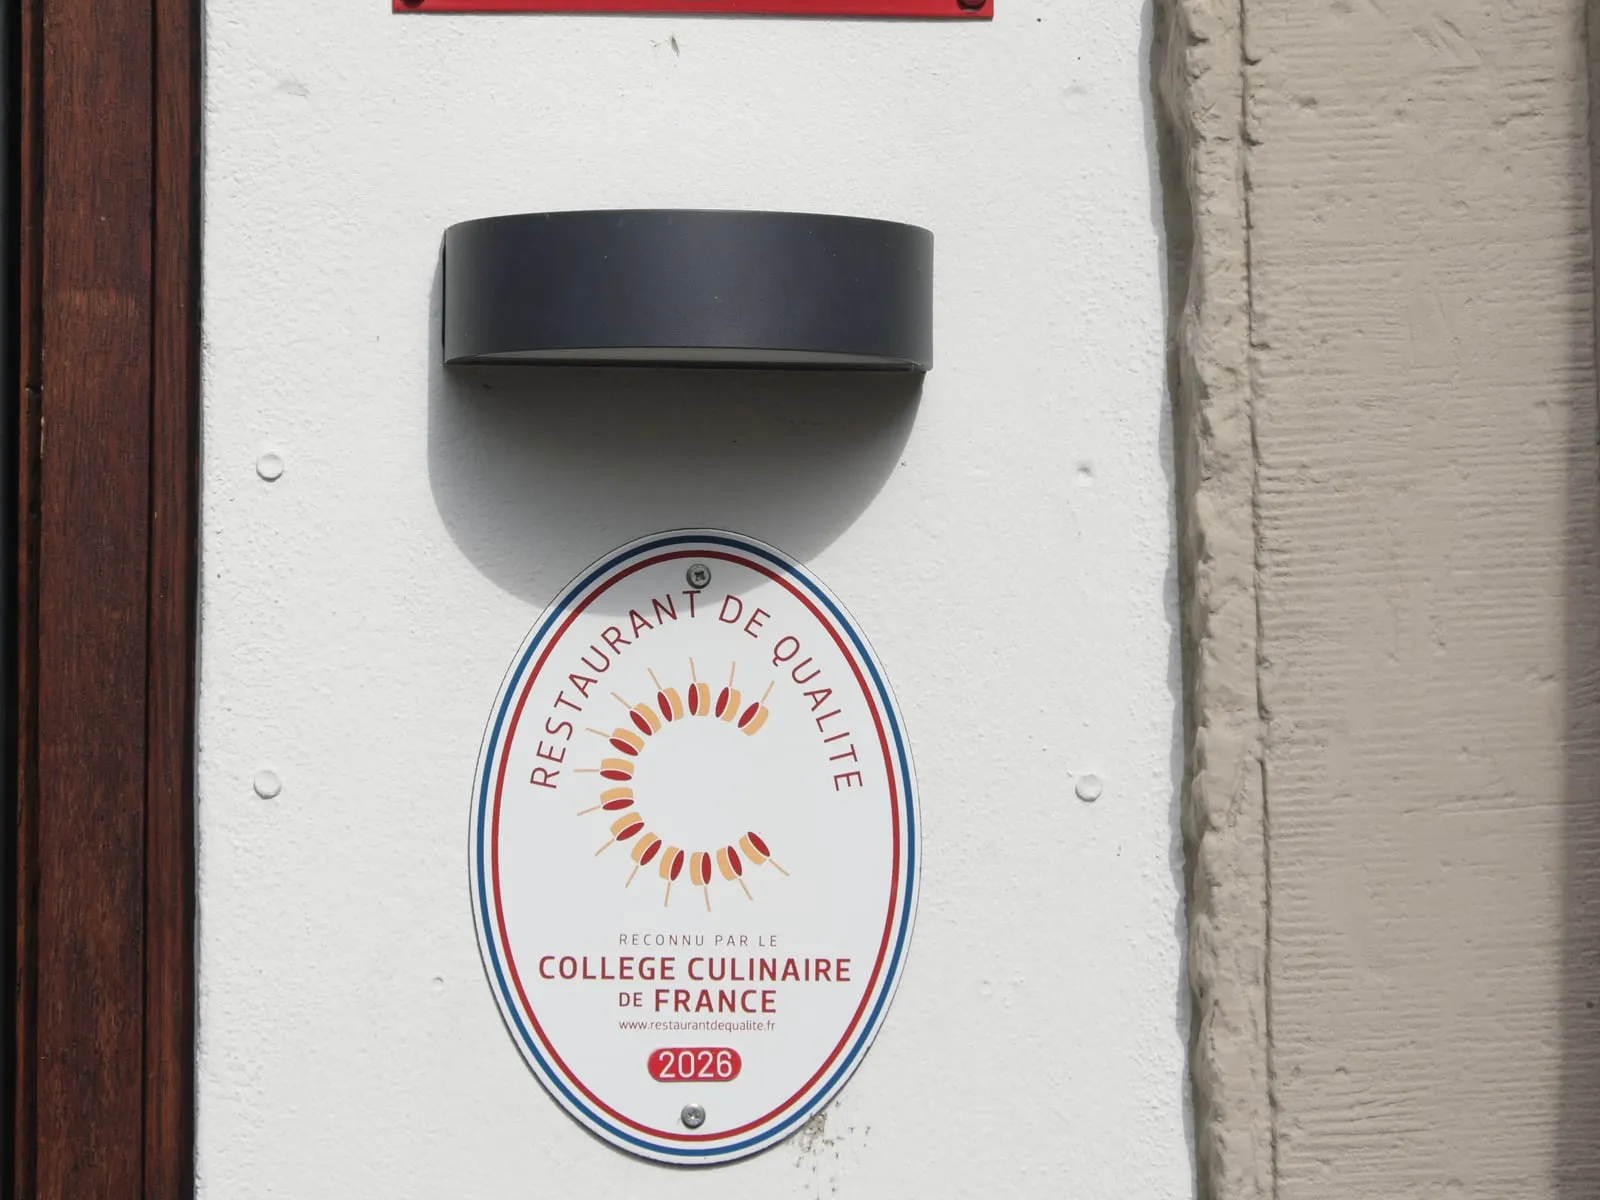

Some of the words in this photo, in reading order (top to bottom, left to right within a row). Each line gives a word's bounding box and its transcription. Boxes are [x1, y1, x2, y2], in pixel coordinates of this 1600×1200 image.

[529, 590, 701, 789] RESTAURANT
[718, 595, 771, 638] DE
[772, 636, 863, 791] QUALITE
[619, 933, 704, 947] RECONNU
[714, 934, 749, 947] PAR
[758, 935, 777, 948] LE
[538, 955, 676, 981] COLLEGE
[687, 957, 851, 982] CULINAIRE
[618, 992, 643, 1007] DE
[654, 989, 777, 1014] FRANCE
[618, 1019, 776, 1033] www.restaurantdequalite.fr
[659, 1051, 733, 1079] 2026
